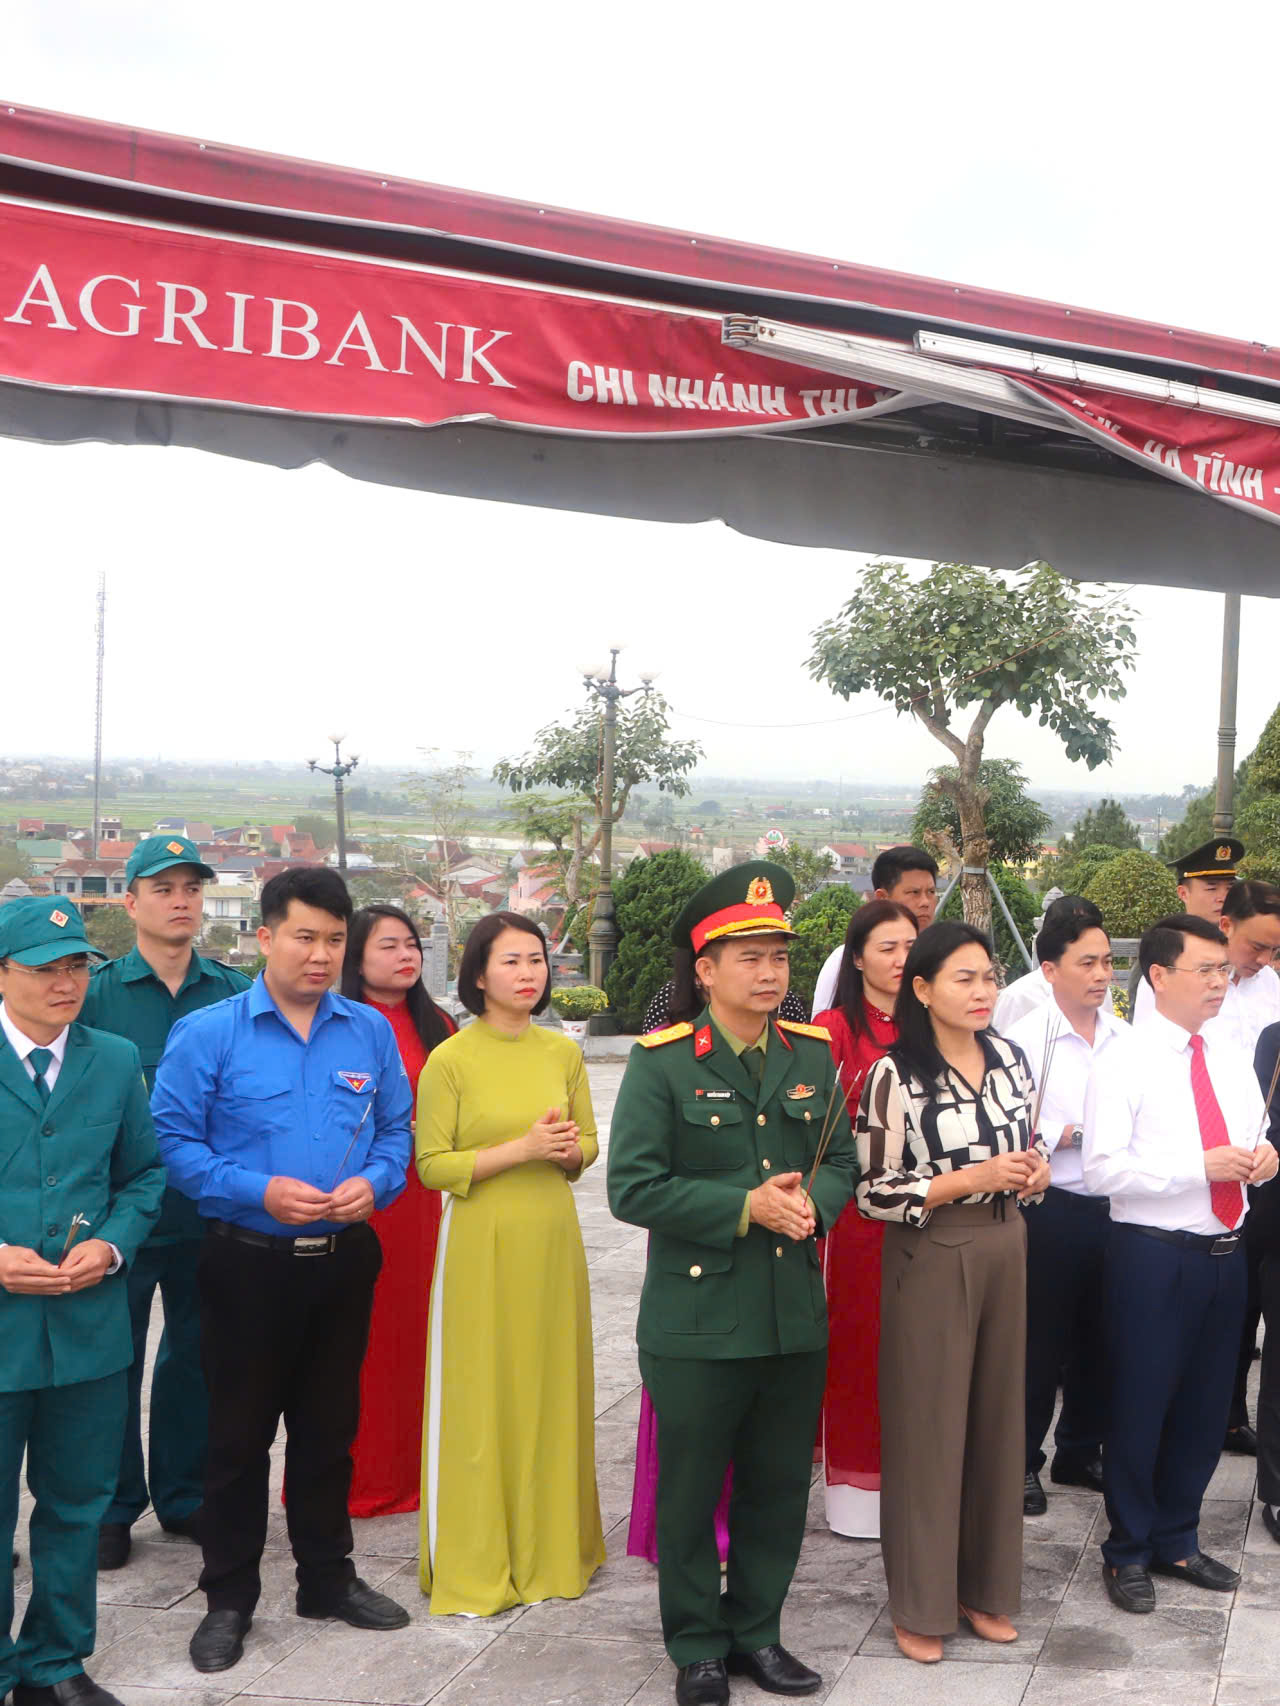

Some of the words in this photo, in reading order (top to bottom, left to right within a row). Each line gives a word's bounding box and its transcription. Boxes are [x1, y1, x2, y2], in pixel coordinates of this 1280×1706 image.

[4, 264, 517, 389] AGRIBANK
[567, 360, 638, 406] CHI
[649, 373, 792, 417] NHÁNH
[1193, 451, 1264, 500] TĨNH
